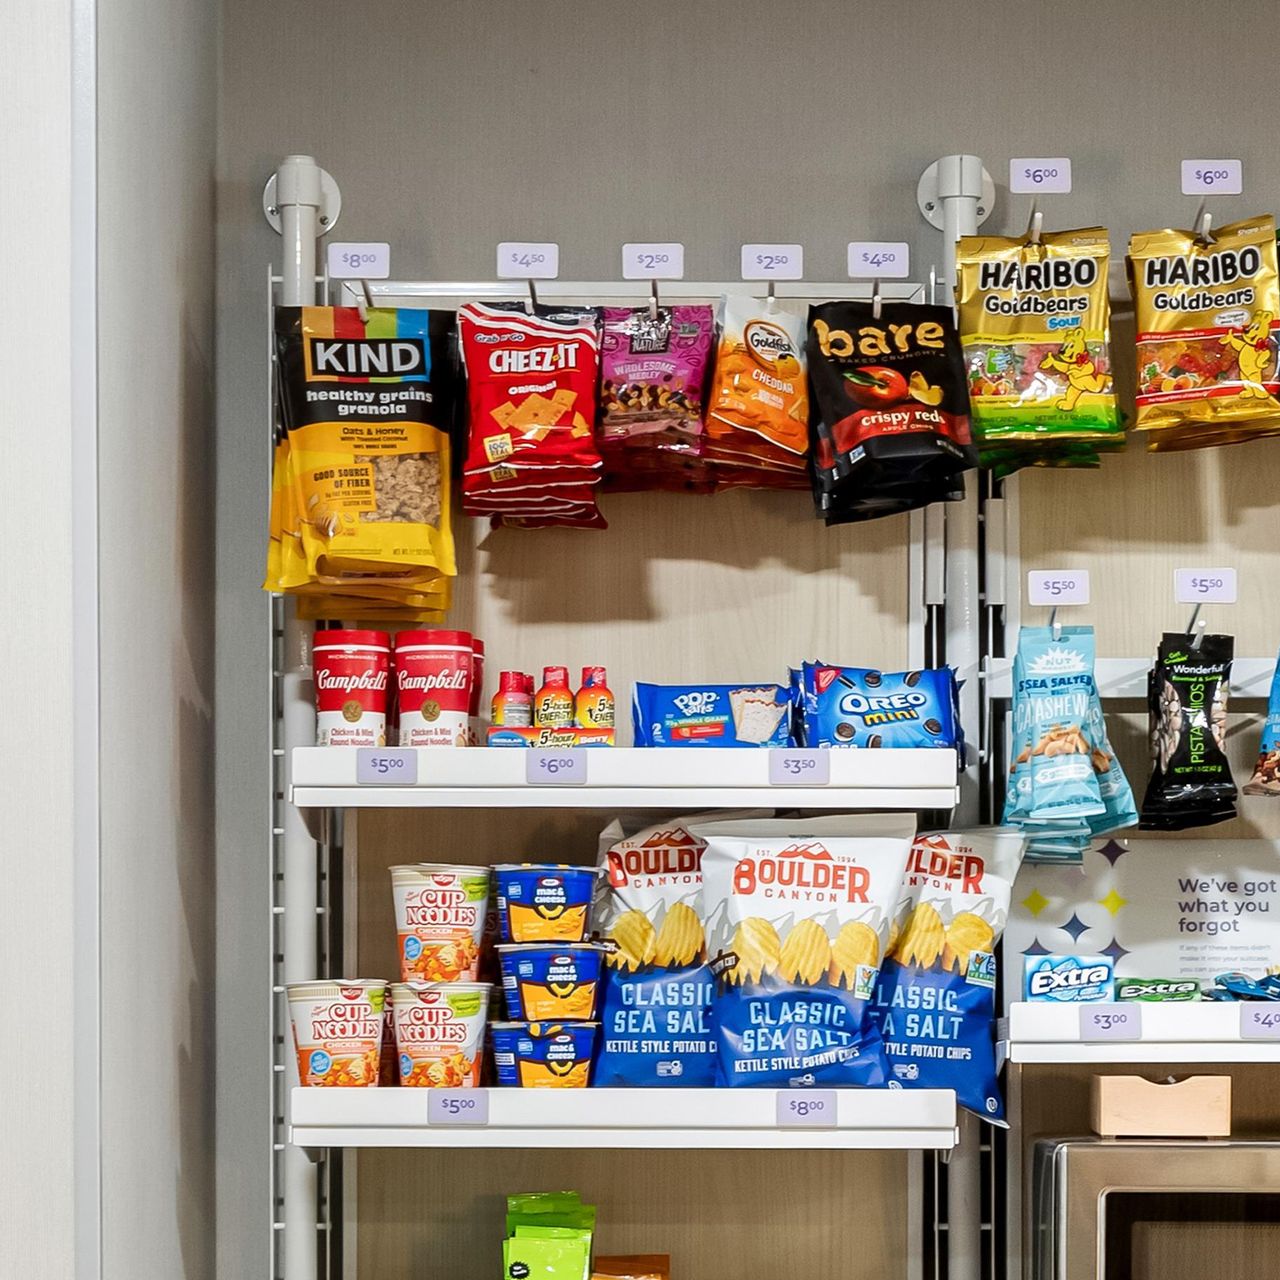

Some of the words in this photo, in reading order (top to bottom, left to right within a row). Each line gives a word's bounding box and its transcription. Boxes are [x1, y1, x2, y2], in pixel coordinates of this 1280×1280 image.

[980, 258, 1096, 291] HARIBO
[1145, 247, 1261, 287] HARIBO
[985, 295, 1088, 316] Goldbears
[1154, 288, 1254, 312] Goldbears
[1047, 315, 1081, 330] Sour
[813, 318, 944, 357] bare
[315, 342, 421, 373] KIND
[614, 360, 676, 376] WHOLESOME
[628, 370, 661, 382] MEDLEY
[752, 368, 795, 394] CHEDDAR
[306, 389, 379, 404] healthy
[380, 387, 433, 404] grains
[337, 403, 407, 416] granola
[860, 410, 911, 427] crispy
[342, 427, 365, 436] Oats
[375, 427, 405, 437] Honey
[339, 466, 369, 479] SOURCE
[346, 478, 371, 488] FIBER
[1173, 663, 1225, 674] Wonderful
[316, 668, 388, 693] Campbell's
[397, 668, 468, 693] Campbell's
[840, 692, 926, 714] OREO
[864, 708, 919, 727] mini
[633, 875, 703, 889] CANYON
[732, 859, 871, 904] BOULDER
[1178, 878, 1238, 893] We've
[1244, 880, 1277, 896] got
[420, 890, 466, 907] CUP
[765, 888, 838, 902] CANYON
[405, 906, 476, 927] NOODLES
[1178, 898, 1229, 913] what
[1234, 901, 1269, 916] you
[1178, 917, 1240, 935] forgot
[1031, 964, 1110, 994] Extra
[621, 983, 713, 1006] CLASSIC
[328, 1004, 372, 1021] CUP
[408, 1007, 453, 1024] CUP
[750, 1002, 846, 1027] CLASSIC
[312, 1020, 379, 1041] NOODLES
[399, 1021, 466, 1043] NOODLES
[614, 1011, 656, 1034] SEA
[906, 1016, 963, 1039] SALT
[606, 1040, 639, 1053] KETTLE
[641, 1040, 671, 1053] STYLE
[672, 1040, 707, 1053] POTATO
[742, 1029, 785, 1052] SEA
[796, 1030, 851, 1050] SALT
[911, 1044, 944, 1058] POTATO
[946, 1046, 972, 1060] CHIPS
[734, 1058, 768, 1073] KETTLE
[771, 1057, 800, 1070] STYLE
[802, 1053, 837, 1069] POTATO
